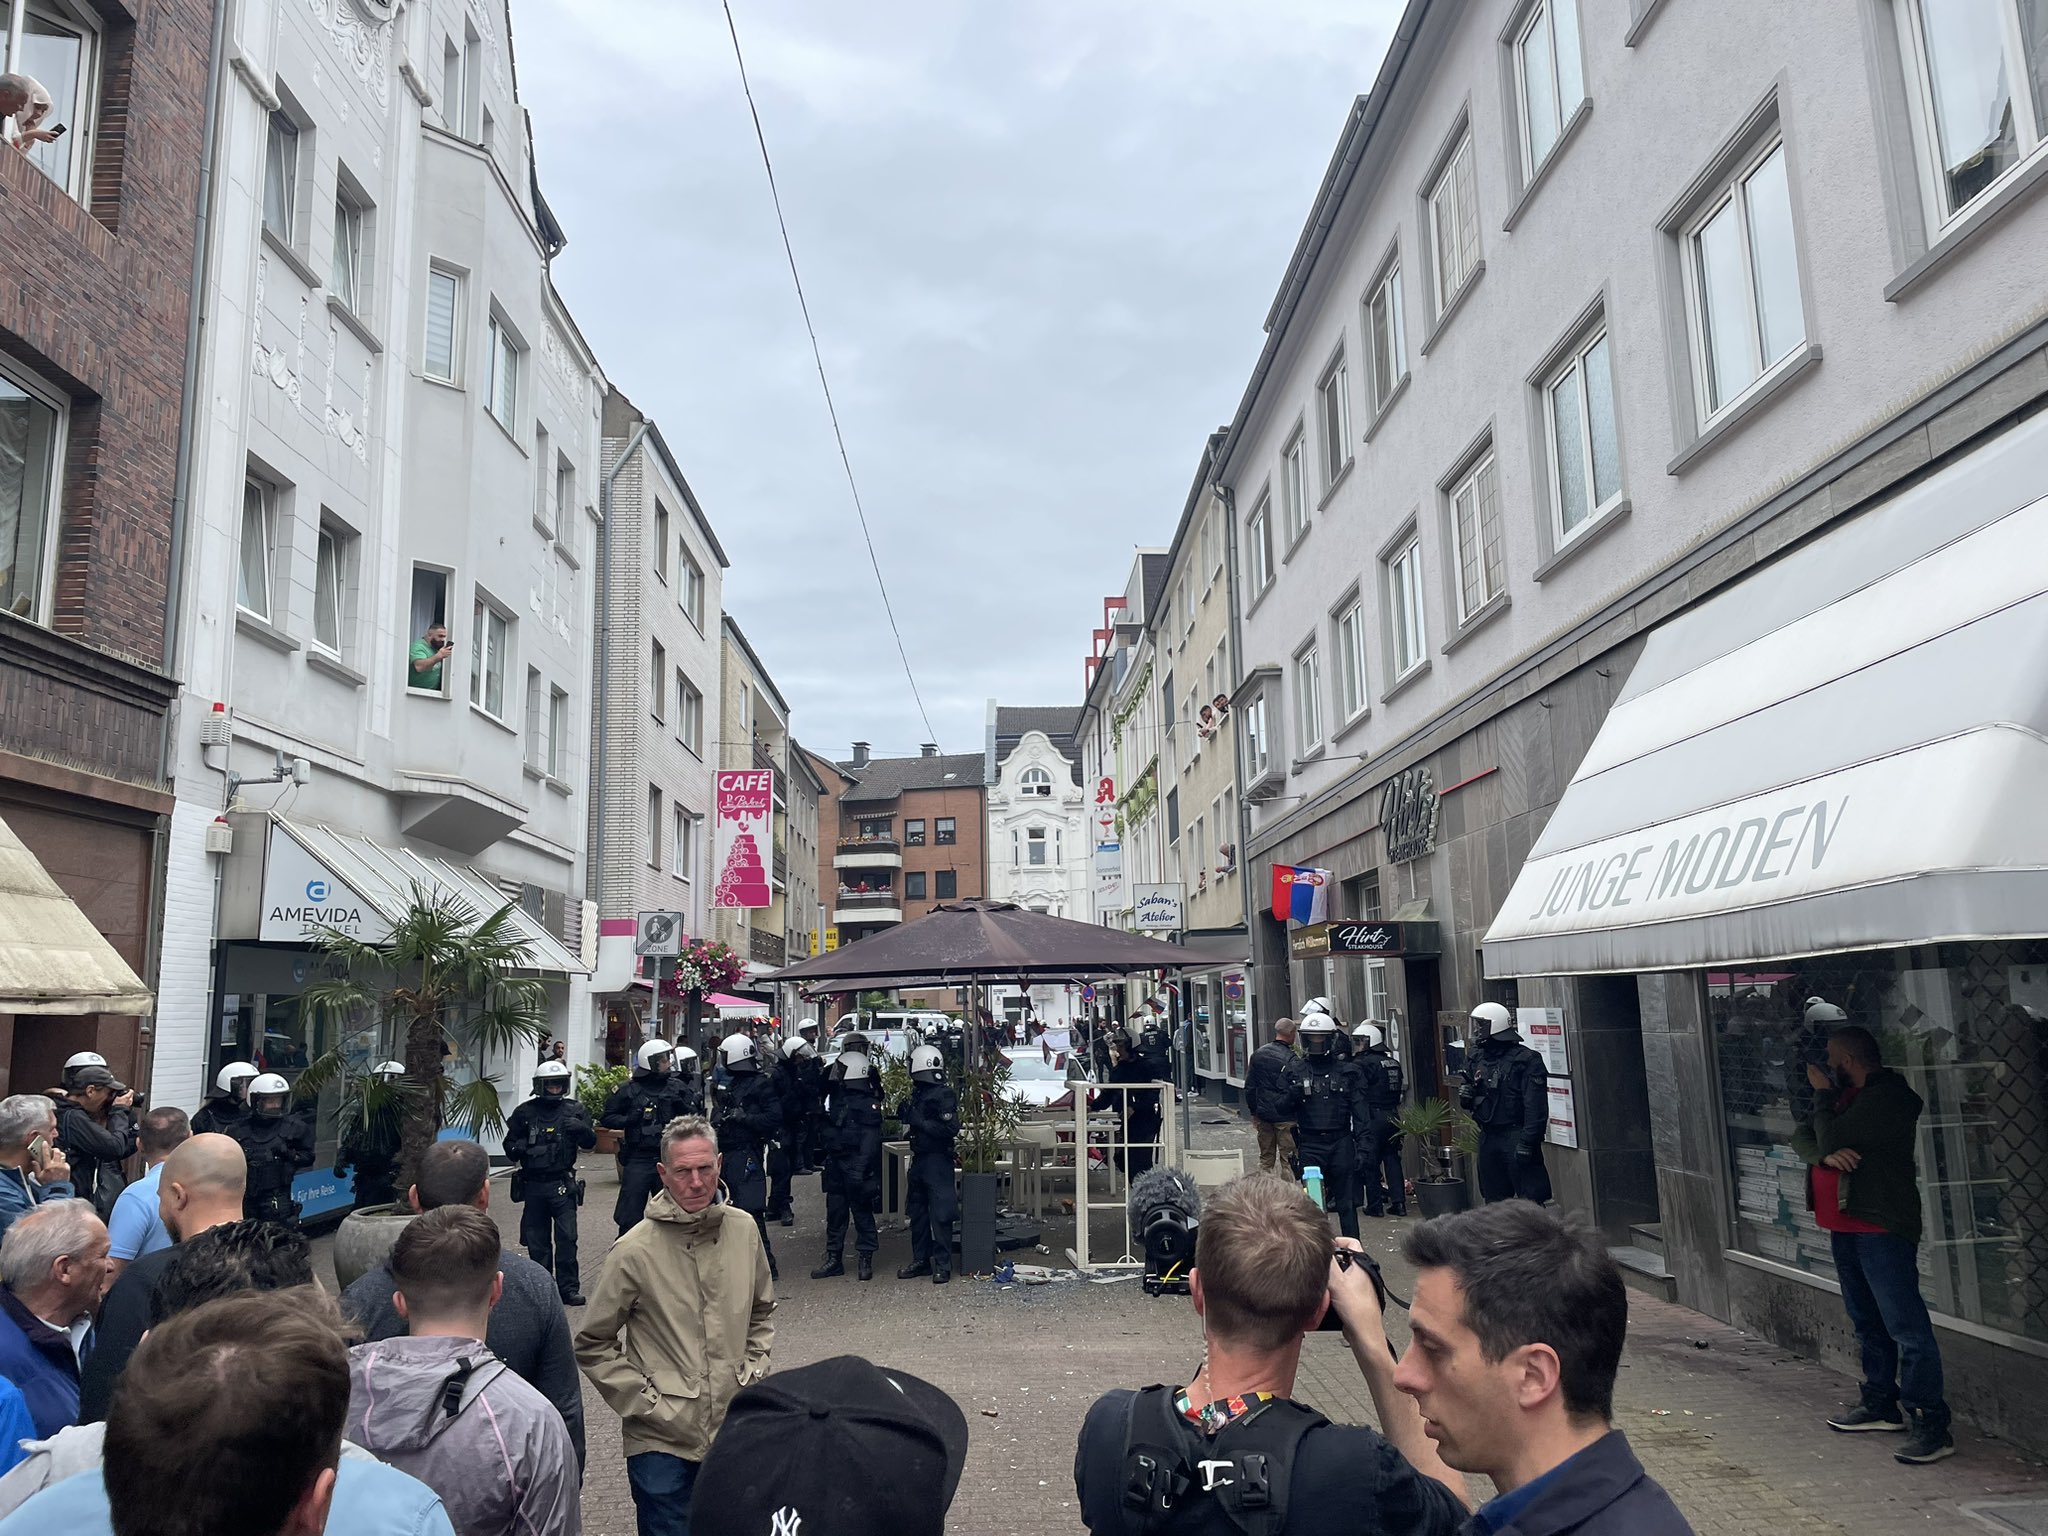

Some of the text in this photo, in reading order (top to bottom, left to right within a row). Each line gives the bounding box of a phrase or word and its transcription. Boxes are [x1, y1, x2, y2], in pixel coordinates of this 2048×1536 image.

[719, 772, 769, 791] CAFÉ
[1529, 795, 1850, 920] JUNGE MODEN
[1137, 891, 1177, 909] Saban's
[269, 906, 361, 923] AMEVIDA
[1140, 909, 1175, 922] Atelier
[1338, 926, 1386, 946] Hirt
[647, 945, 668, 953] ZONE
[743, 1047, 749, 1057] 6
[861, 1066, 867, 1075] 6
[926, 1058, 933, 1068] 6
